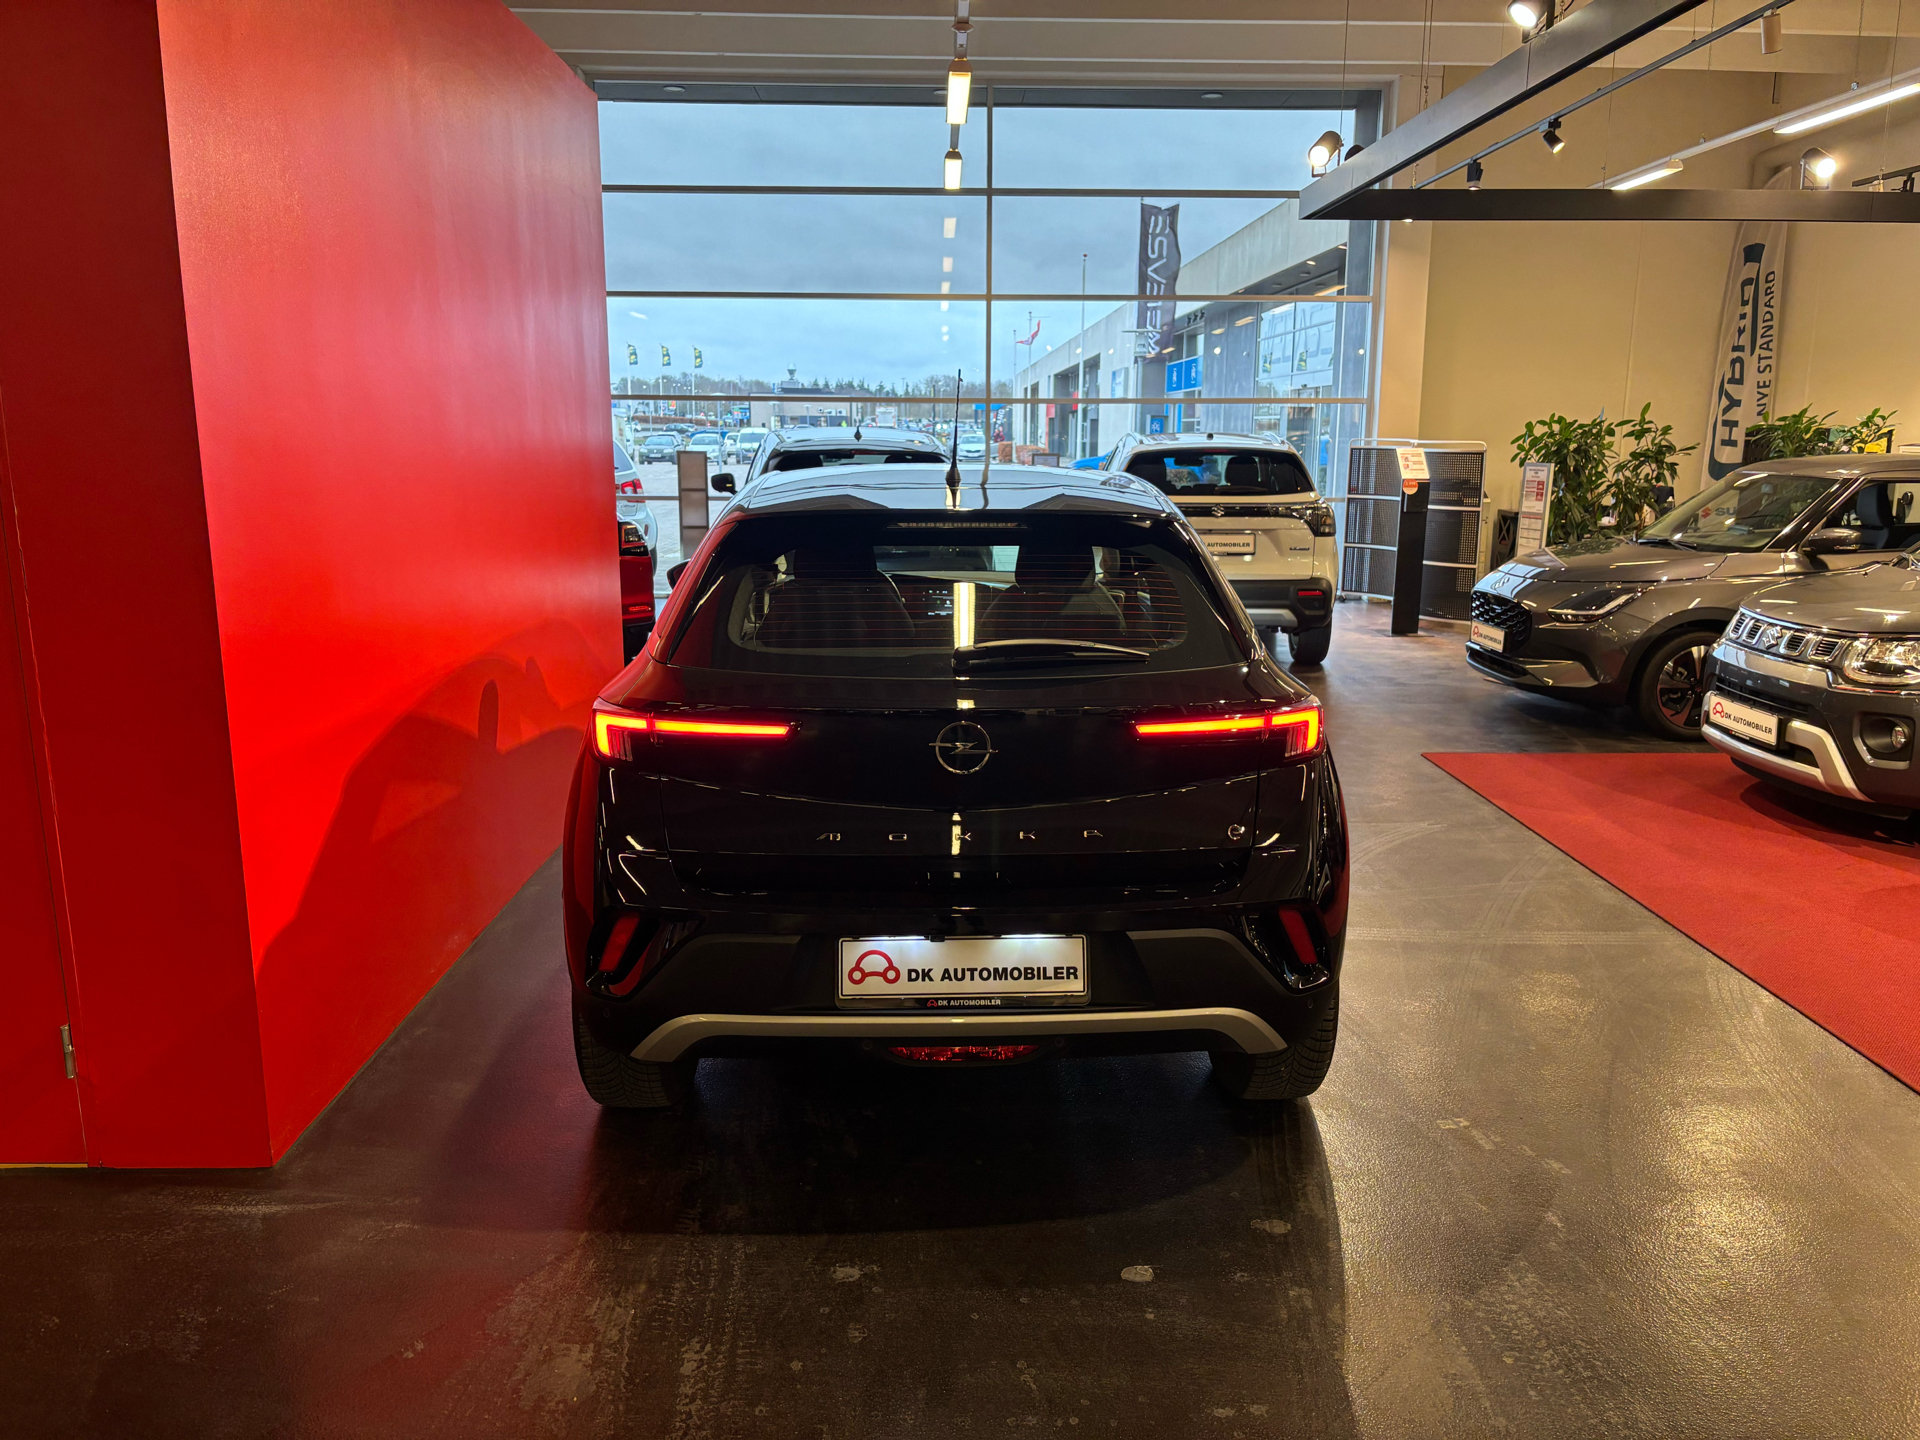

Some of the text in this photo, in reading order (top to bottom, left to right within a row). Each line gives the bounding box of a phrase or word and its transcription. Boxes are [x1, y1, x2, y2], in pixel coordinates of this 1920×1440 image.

[1721, 277, 1755, 448] HYBRID
[1756, 270, 1776, 417] NYE STANDARD
[1725, 712, 1772, 735] DK AUTOMOBILER
[907, 966, 1079, 983] DK AUTOMOBILER
